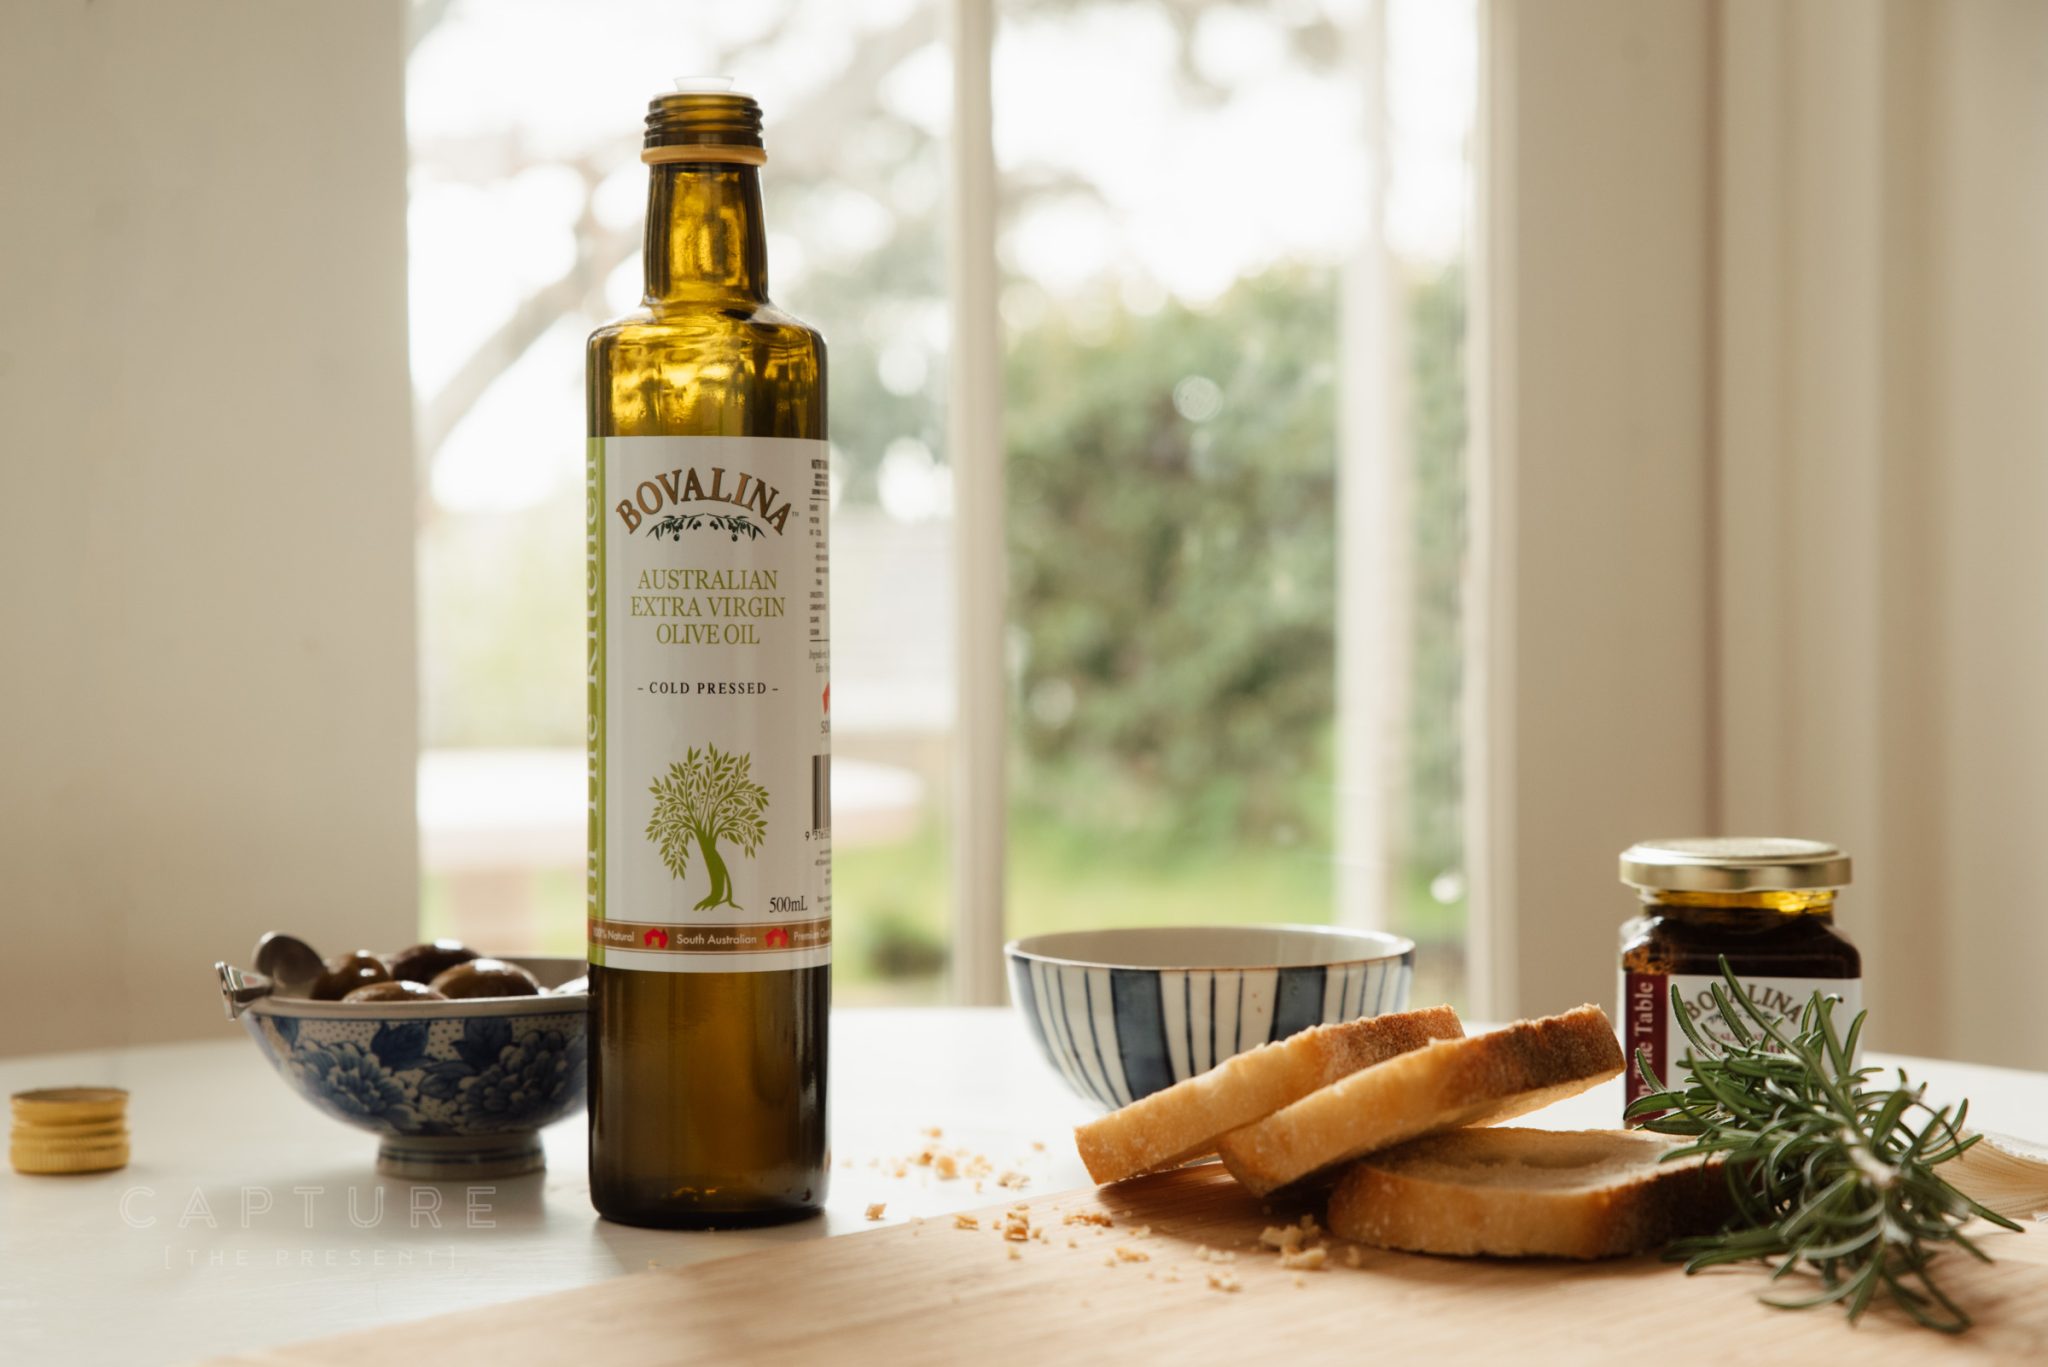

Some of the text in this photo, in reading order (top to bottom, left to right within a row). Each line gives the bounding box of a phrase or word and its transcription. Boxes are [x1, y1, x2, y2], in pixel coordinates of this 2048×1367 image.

[616, 467, 792, 536] BOVALINA
[638, 569, 778, 590] AUSTRALIAN
[631, 596, 786, 617] EXTRA VIRGIN
[656, 623, 760, 645] OLIVE OIL
[649, 681, 767, 694] COLD PRESSED
[769, 895, 808, 913] 500mL
[607, 929, 635, 943] Natural
[676, 933, 757, 945] South Australian
[1634, 981, 1653, 1037] Table
